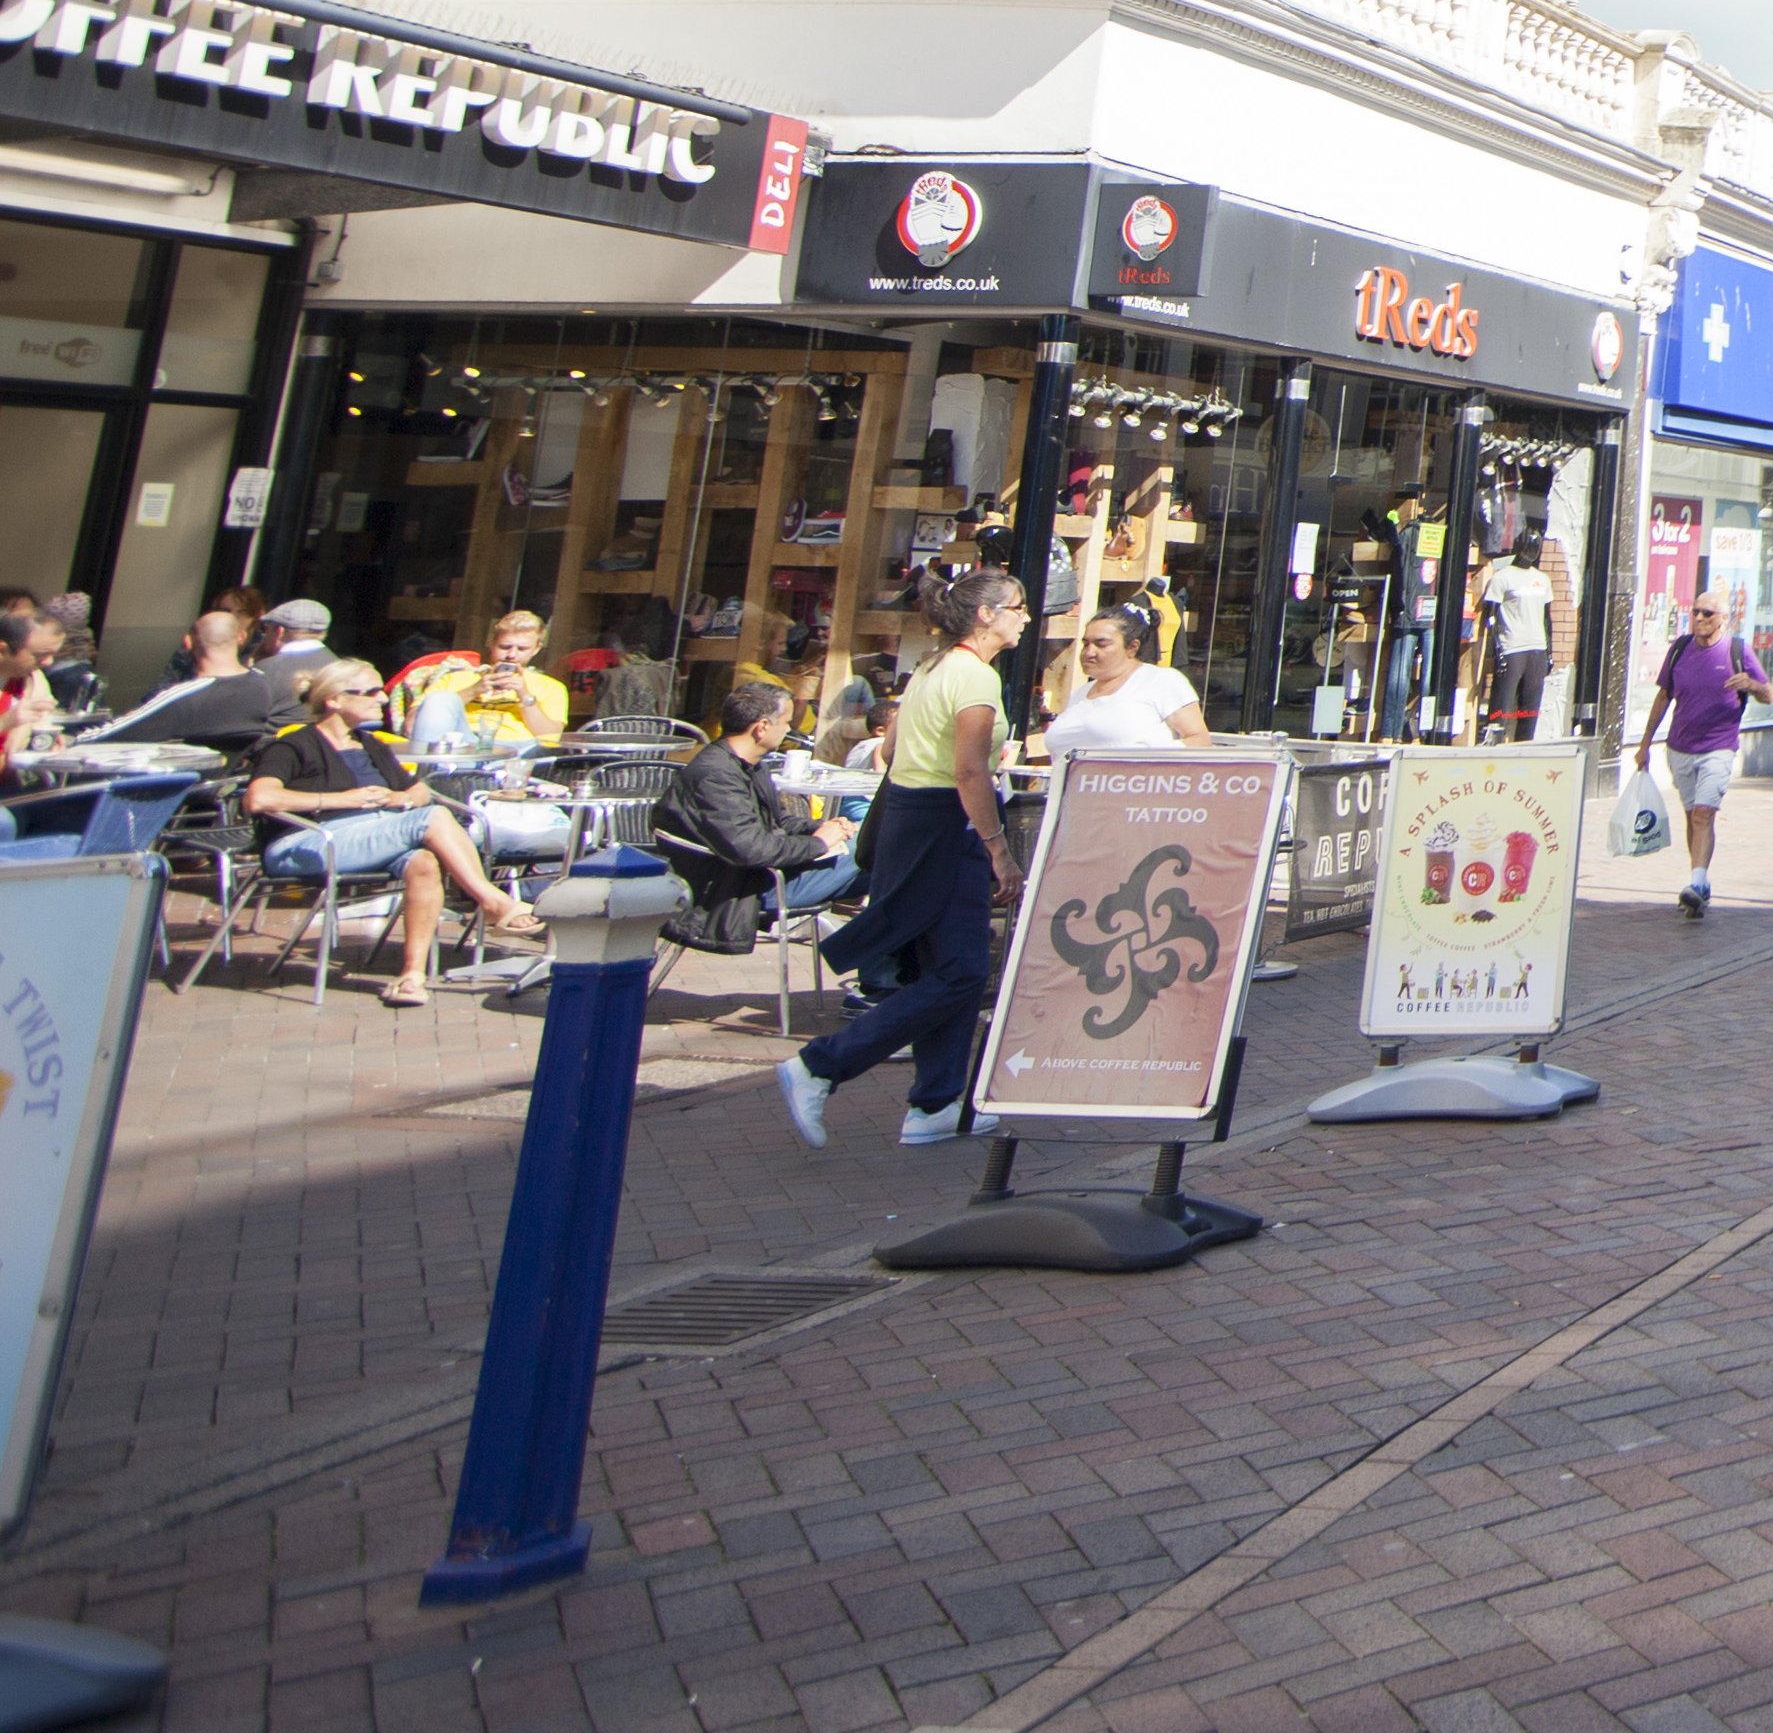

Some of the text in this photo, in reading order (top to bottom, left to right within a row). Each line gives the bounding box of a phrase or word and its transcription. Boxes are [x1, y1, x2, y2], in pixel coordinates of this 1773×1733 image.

[306, 24, 722, 184] REPUBLIC
[760, 140, 800, 228] DELI
[869, 275, 1000, 292] www.treds.co.uk
[1118, 266, 1171, 285] tReds
[1355, 266, 1479, 358] tReds
[1331, 588, 1359, 598] OPEN
[1078, 772, 1262, 795] HIGGINS & CO
[1336, 771, 1390, 817] COF
[1125, 806, 1208, 823] TATTOO
[1399, 779, 1560, 858] A SPLASH OF SUMMER
[1396, 1000, 1530, 1013] COFFEE REPUBLIC
[2, 976, 64, 1119] TWIST
[1040, 1056, 1202, 1072] ABOVE COFFEE REPUBLIC
